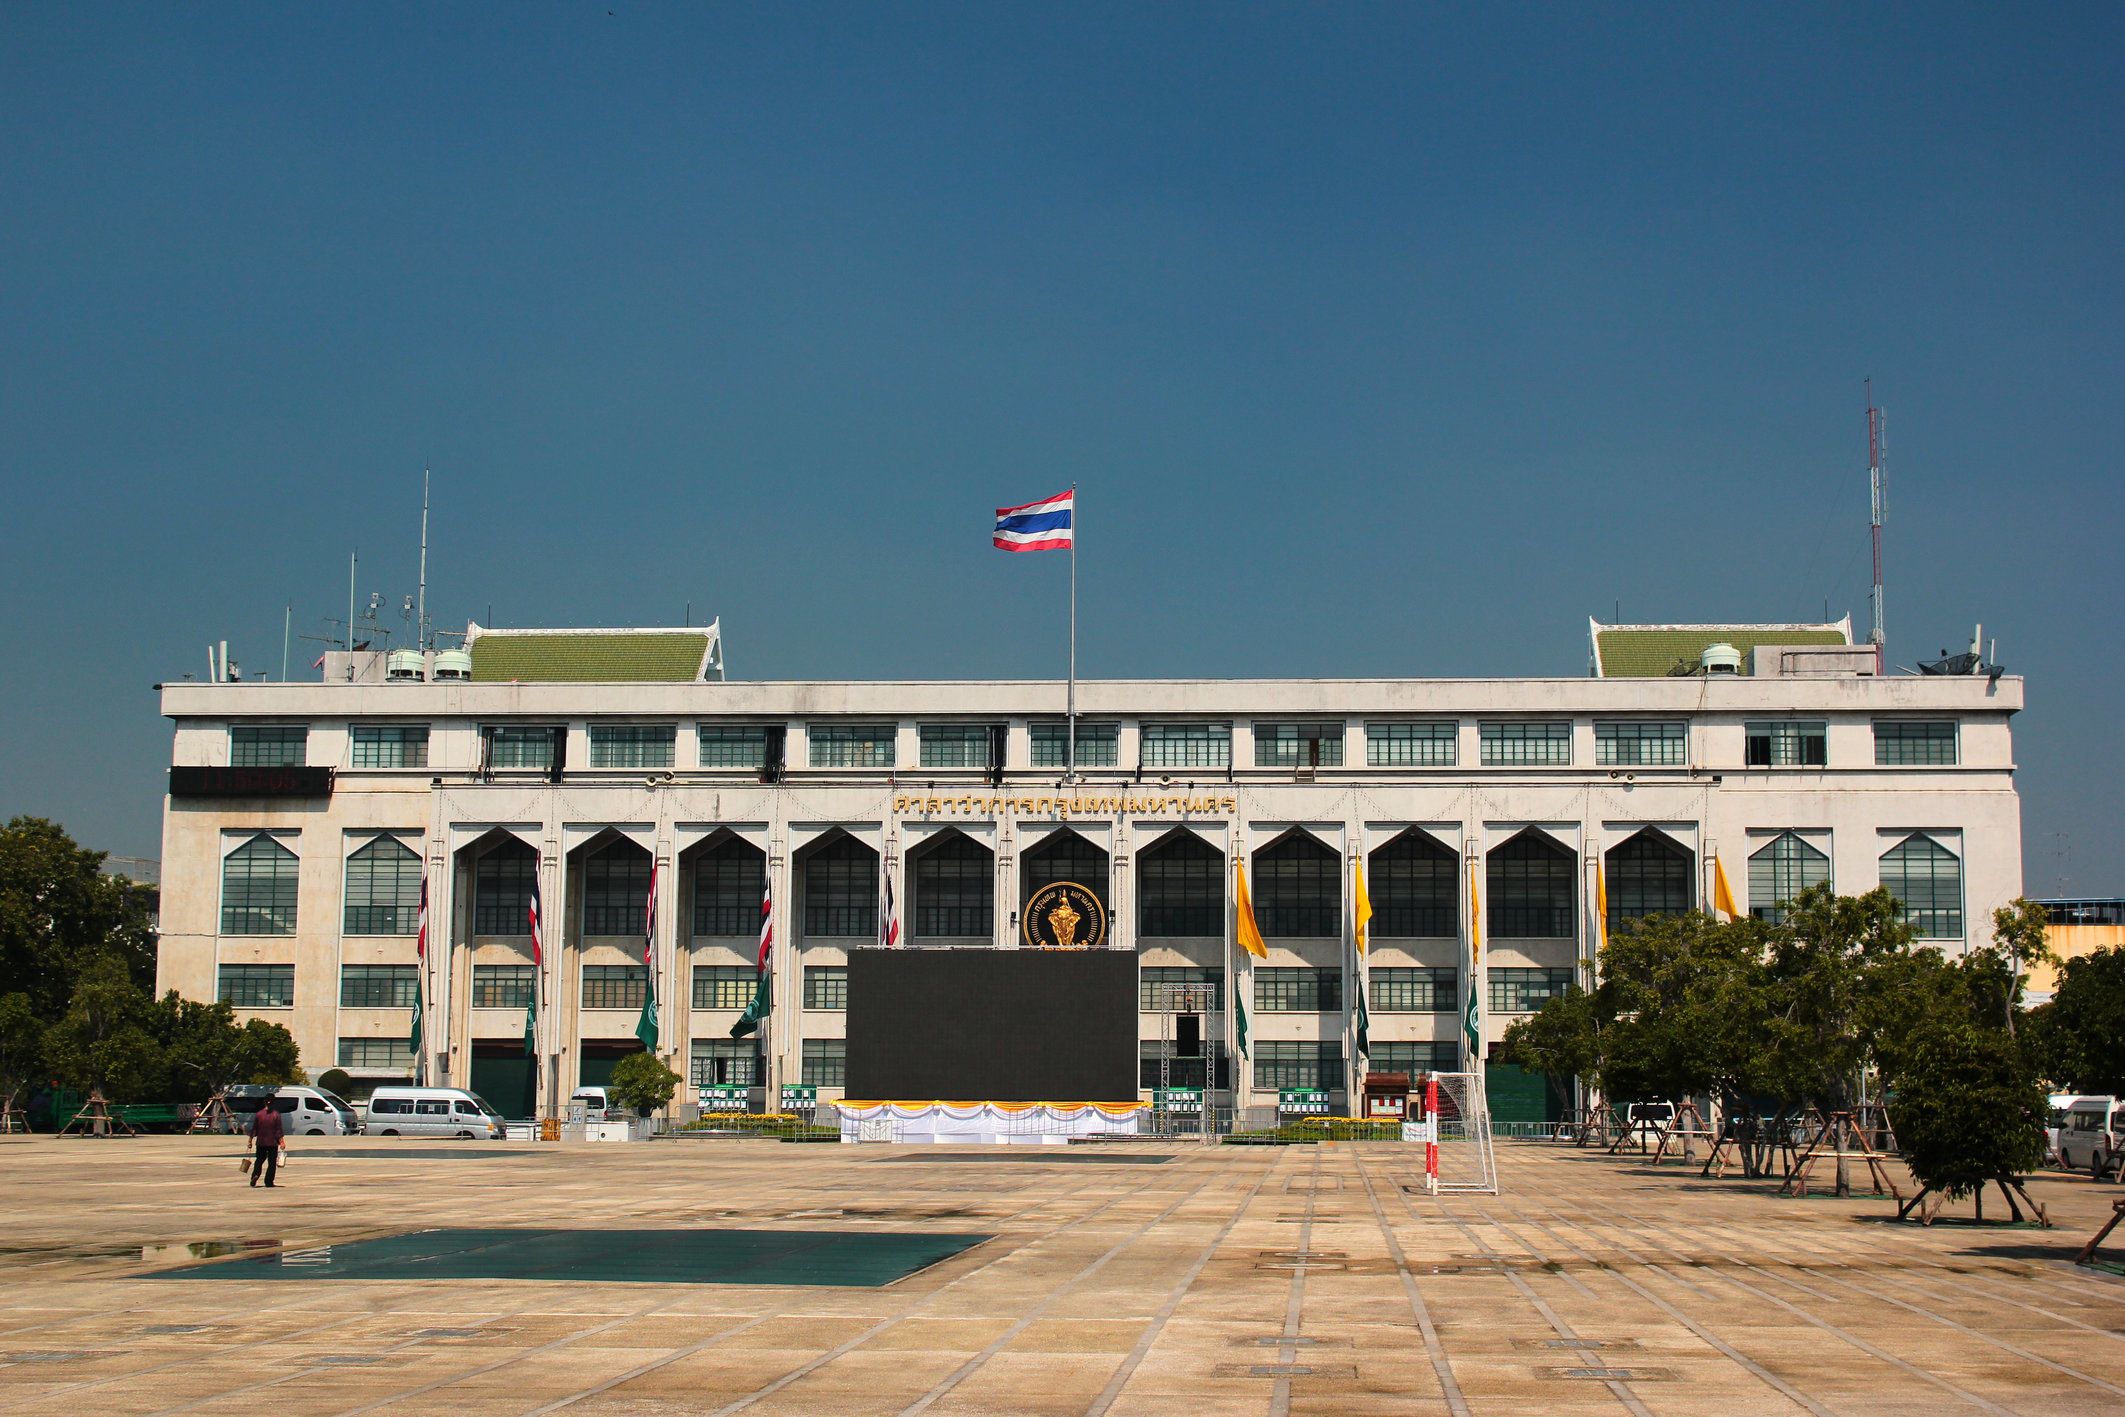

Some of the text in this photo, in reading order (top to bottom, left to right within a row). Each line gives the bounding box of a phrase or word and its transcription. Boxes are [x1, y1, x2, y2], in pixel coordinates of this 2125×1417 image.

[893, 795, 1236, 820] ศาลาว่าการกรุงเทพมหานคร
